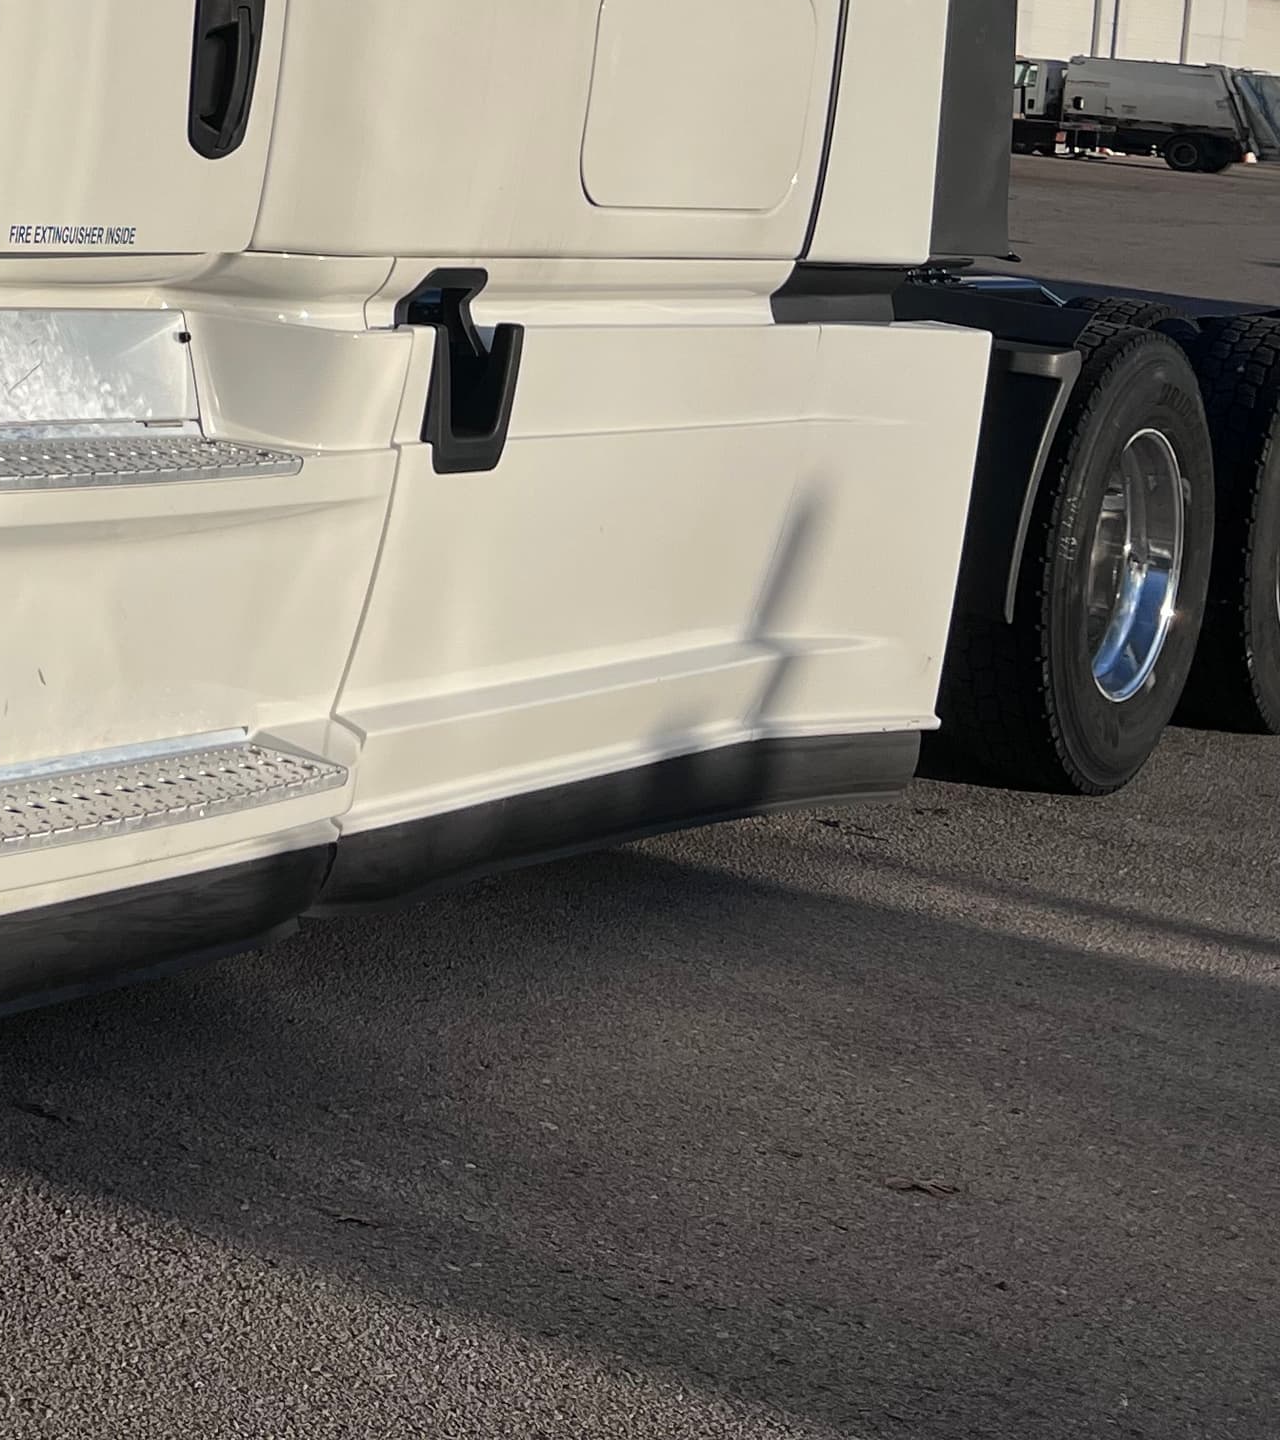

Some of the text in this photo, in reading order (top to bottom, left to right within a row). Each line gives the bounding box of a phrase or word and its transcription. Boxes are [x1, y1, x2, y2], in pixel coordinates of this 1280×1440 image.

[9, 225, 137, 245] FIRE EXTINGUISHER INSIDE
